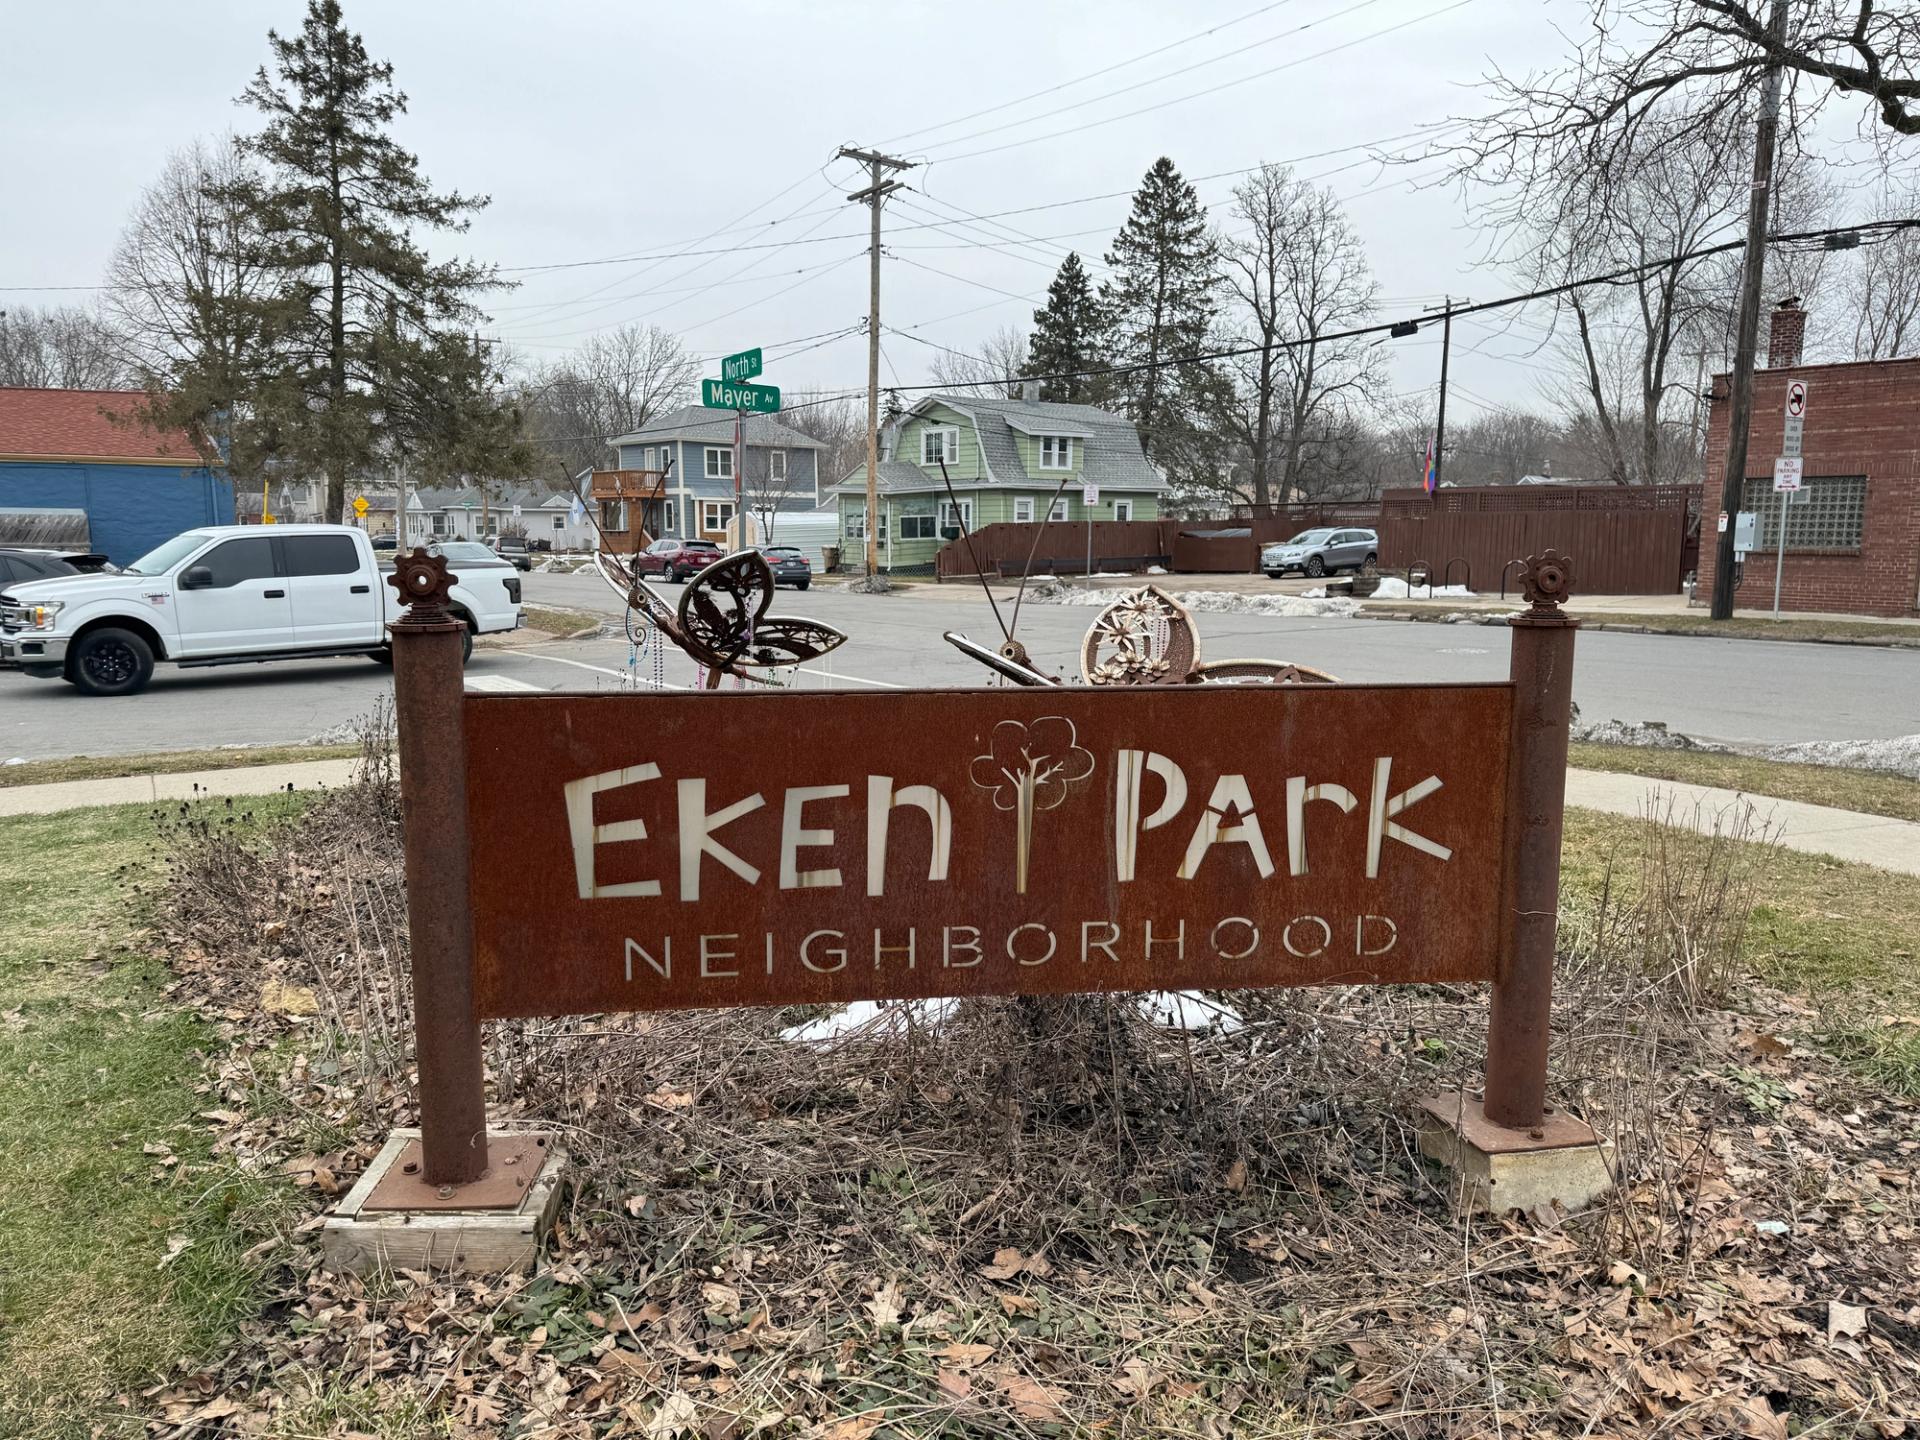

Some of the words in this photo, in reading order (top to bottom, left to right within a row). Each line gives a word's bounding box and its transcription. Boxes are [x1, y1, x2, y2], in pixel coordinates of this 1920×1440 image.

[725, 355, 749, 380] North
[751, 357, 757, 369] St
[711, 383, 758, 408] Mayer
[765, 394, 774, 404] Av
[624, 914, 1398, 982] NEIGHBORHOOD
